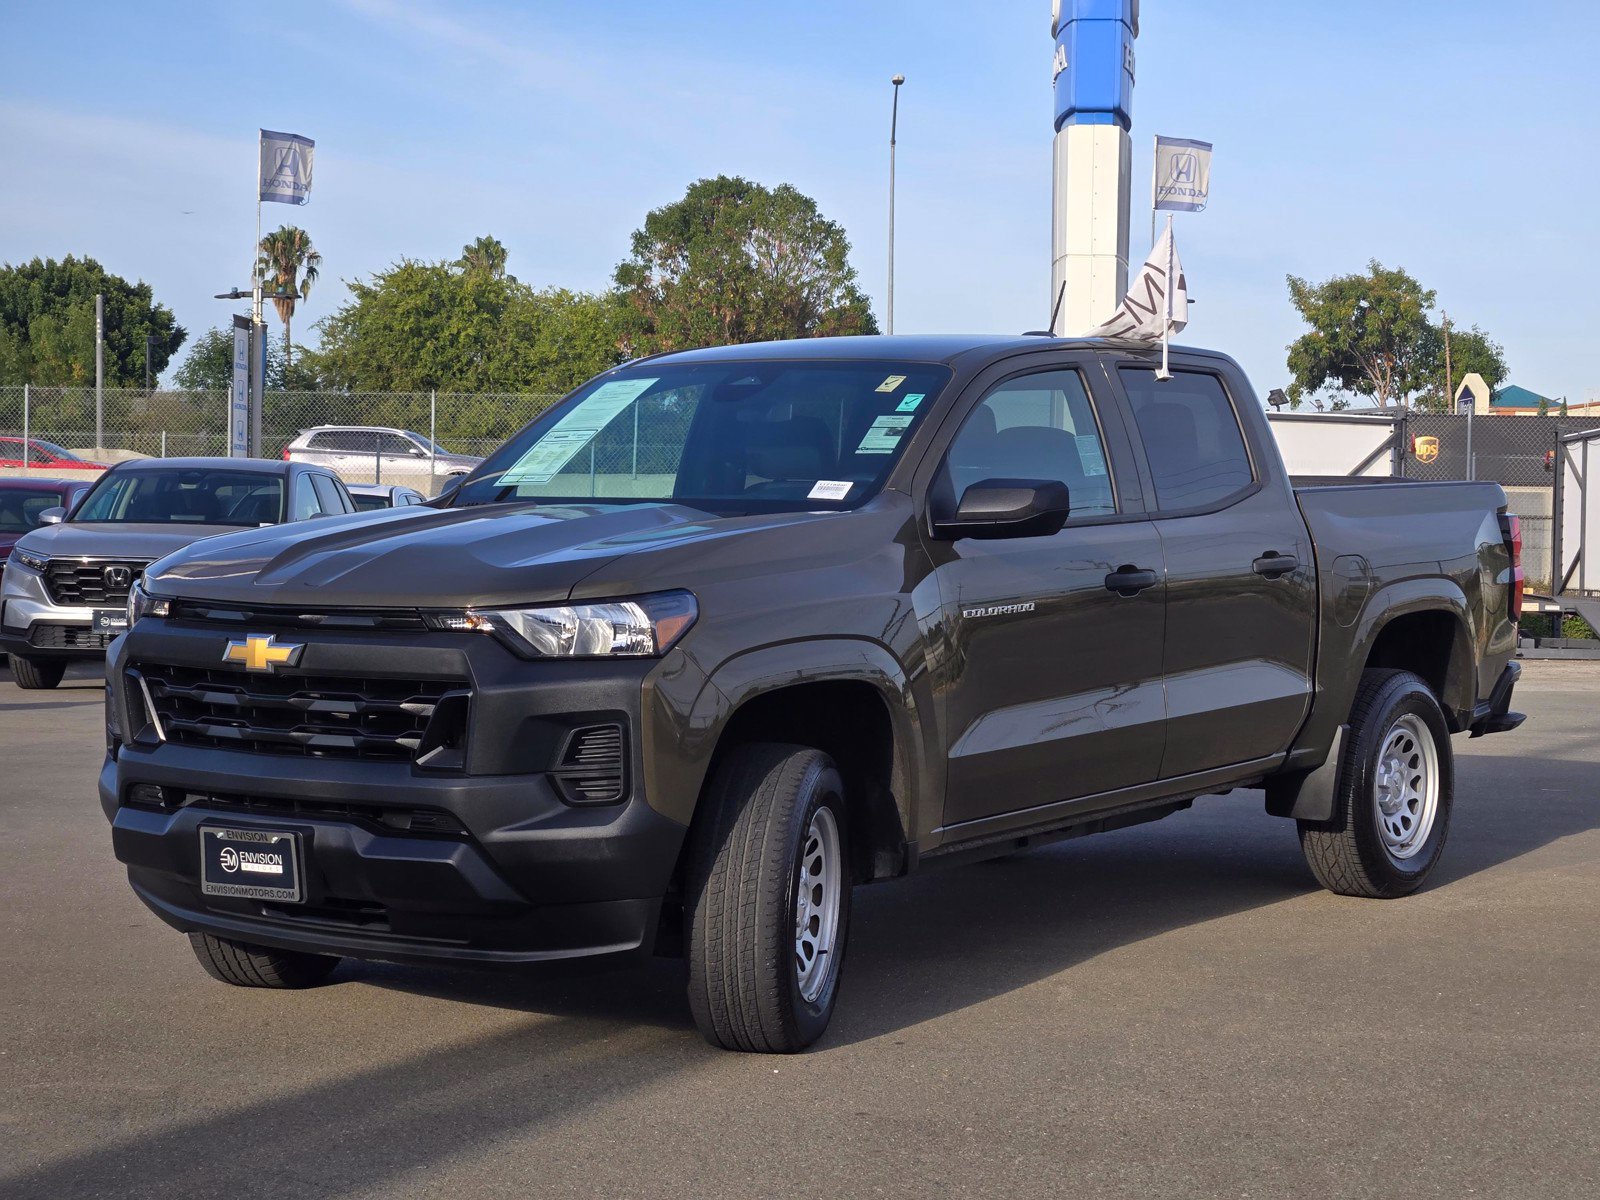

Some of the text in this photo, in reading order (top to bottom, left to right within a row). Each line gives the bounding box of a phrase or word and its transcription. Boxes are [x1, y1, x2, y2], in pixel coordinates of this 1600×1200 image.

[263, 178, 308, 192] HONDA
[1158, 186, 1207, 198] HONDA
[963, 602, 1035, 618] COLORADO
[226, 830, 268, 842] ENVISION
[239, 851, 283, 865] ENVISION
[206, 885, 295, 899] ENVISIONMOTORS.COM
